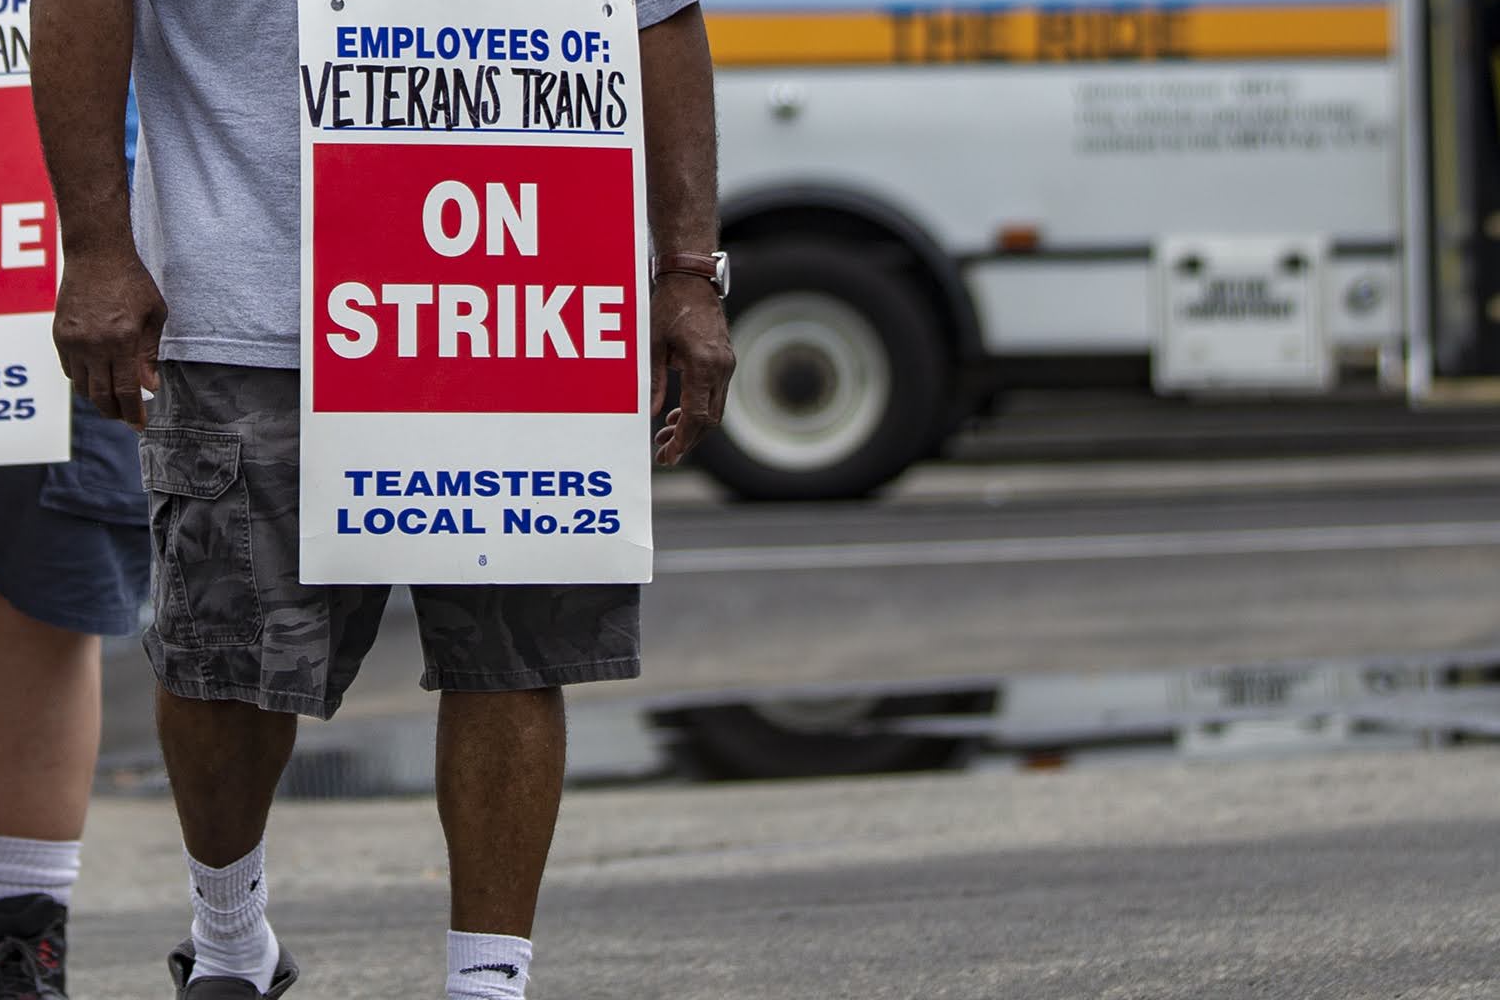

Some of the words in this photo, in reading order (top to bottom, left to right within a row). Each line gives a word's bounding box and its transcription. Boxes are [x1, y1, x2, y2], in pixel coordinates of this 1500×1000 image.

[336, 26, 550, 62] EMPLOYEES
[561, 30, 610, 63] OF:
[300, 61, 502, 131] VETERANS
[513, 66, 627, 130] TRANS
[422, 180, 539, 257] ON
[326, 282, 626, 359] STRIKE
[345, 470, 612, 497] TEAMSTERS
[337, 508, 485, 535] LOCAL
[503, 508, 621, 535] No.25
